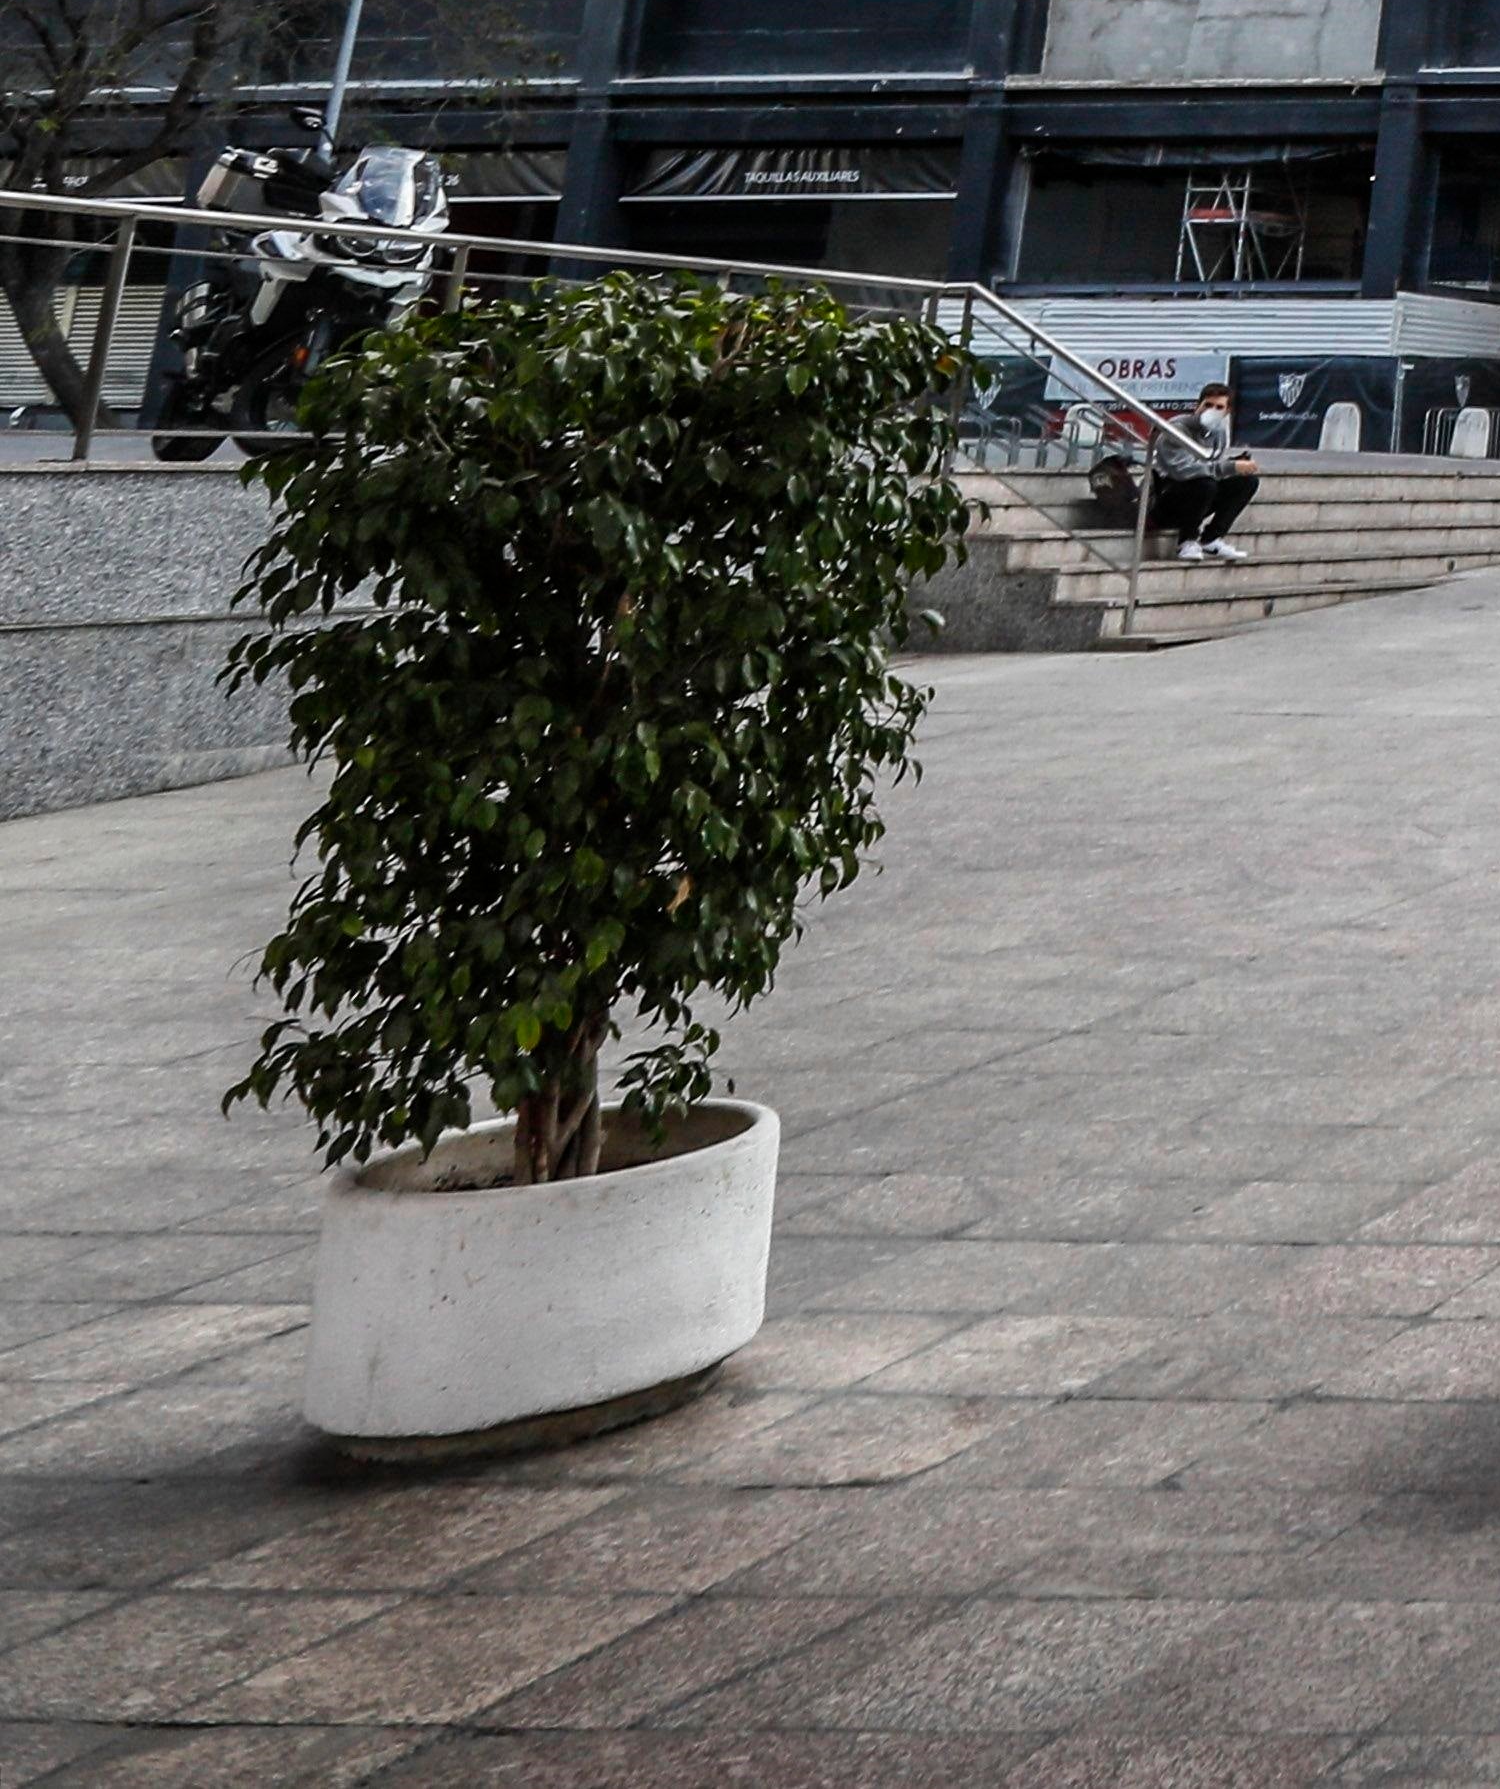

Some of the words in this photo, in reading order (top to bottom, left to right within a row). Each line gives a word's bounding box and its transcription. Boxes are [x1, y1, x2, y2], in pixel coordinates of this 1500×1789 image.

[744, 170, 800, 184] TAQUILLAS
[800, 170, 860, 183] AUXILIARES
[1099, 359, 1177, 379] OBRAS
